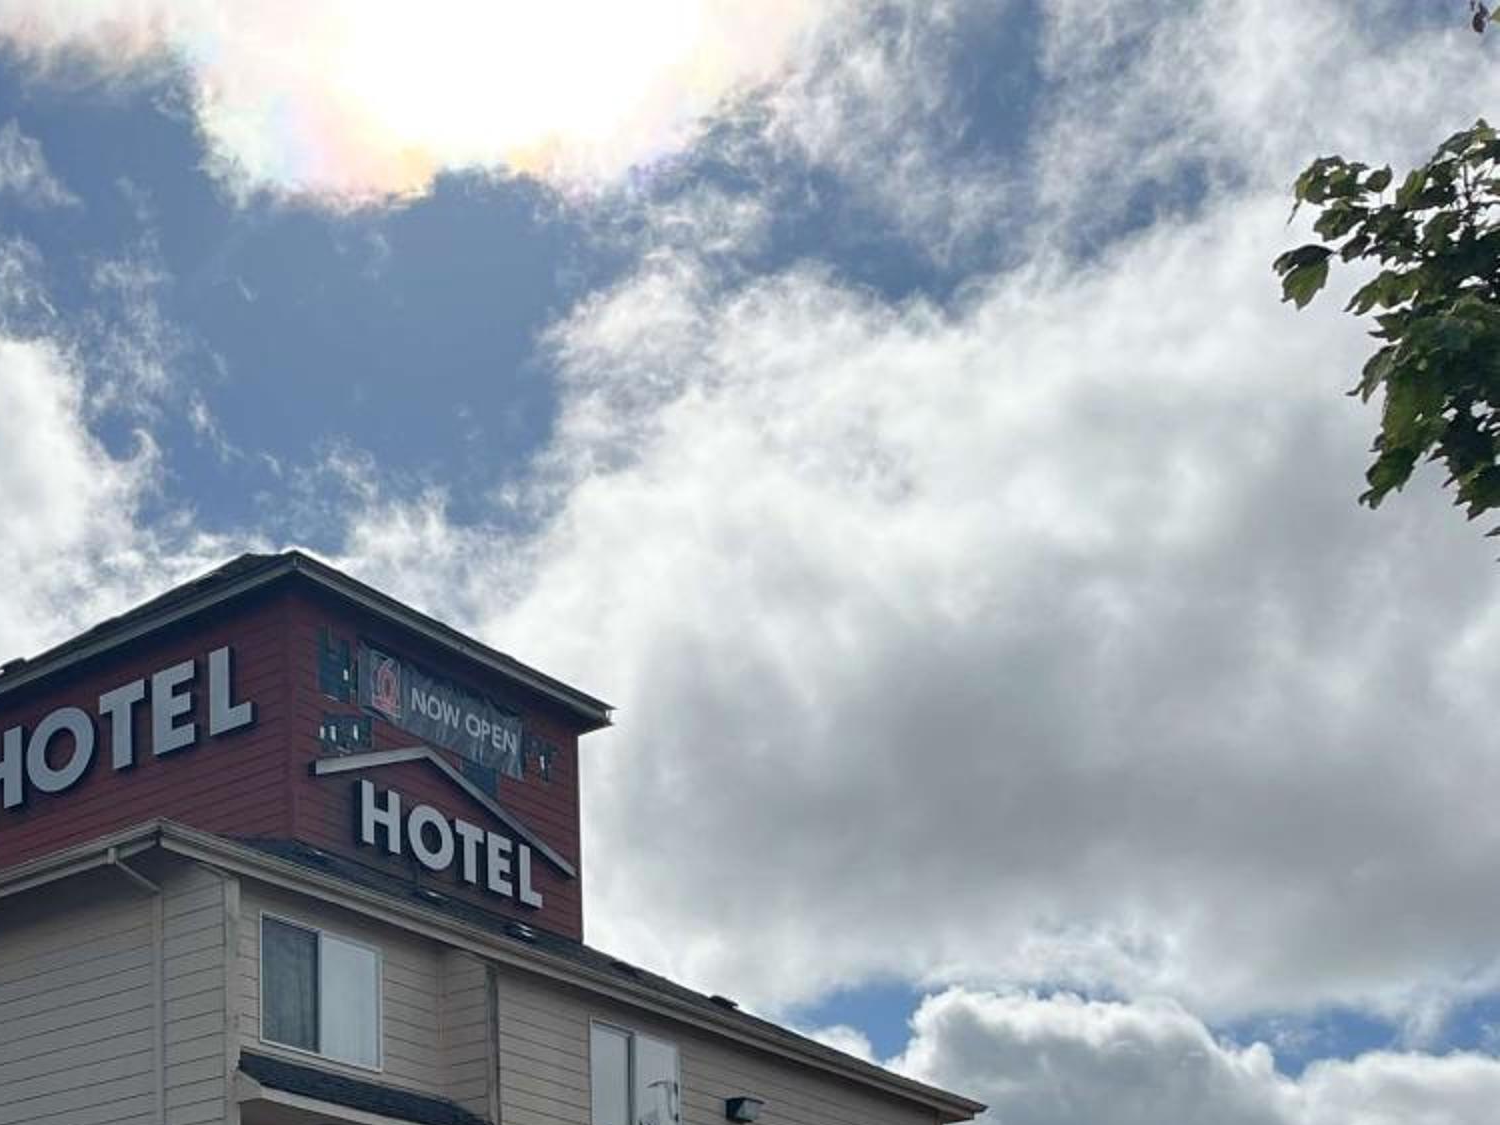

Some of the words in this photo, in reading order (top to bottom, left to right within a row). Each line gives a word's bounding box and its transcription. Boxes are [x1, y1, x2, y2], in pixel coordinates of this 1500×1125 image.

[411, 687, 461, 729] NOW
[465, 712, 518, 754] OPEN
[361, 779, 543, 909] HOTEL
